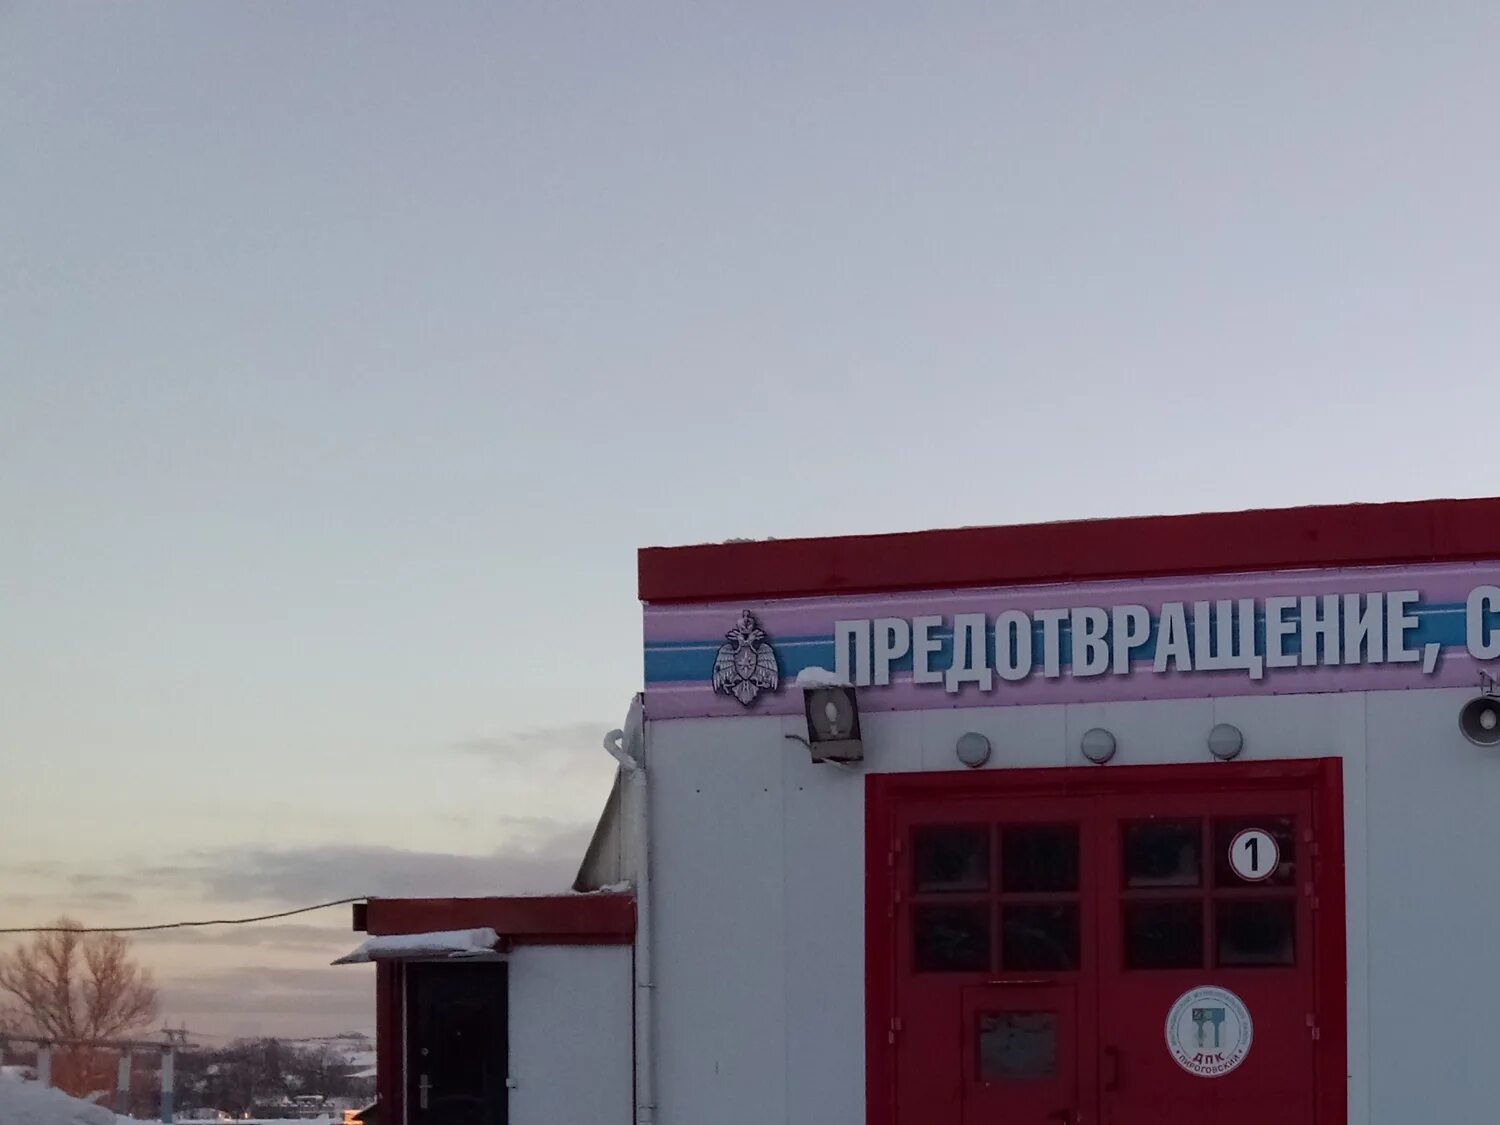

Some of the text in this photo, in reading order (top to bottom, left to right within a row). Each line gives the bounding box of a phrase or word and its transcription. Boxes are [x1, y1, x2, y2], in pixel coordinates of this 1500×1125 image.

[834, 589, 1441, 693] ПРЕДОТВРАЩЕНИЕ,
[1244, 837, 1258, 871] 1
[1179, 1054, 1240, 1074] ПИРОГОВСКИЙ
[1192, 1051, 1225, 1065] ДПК
